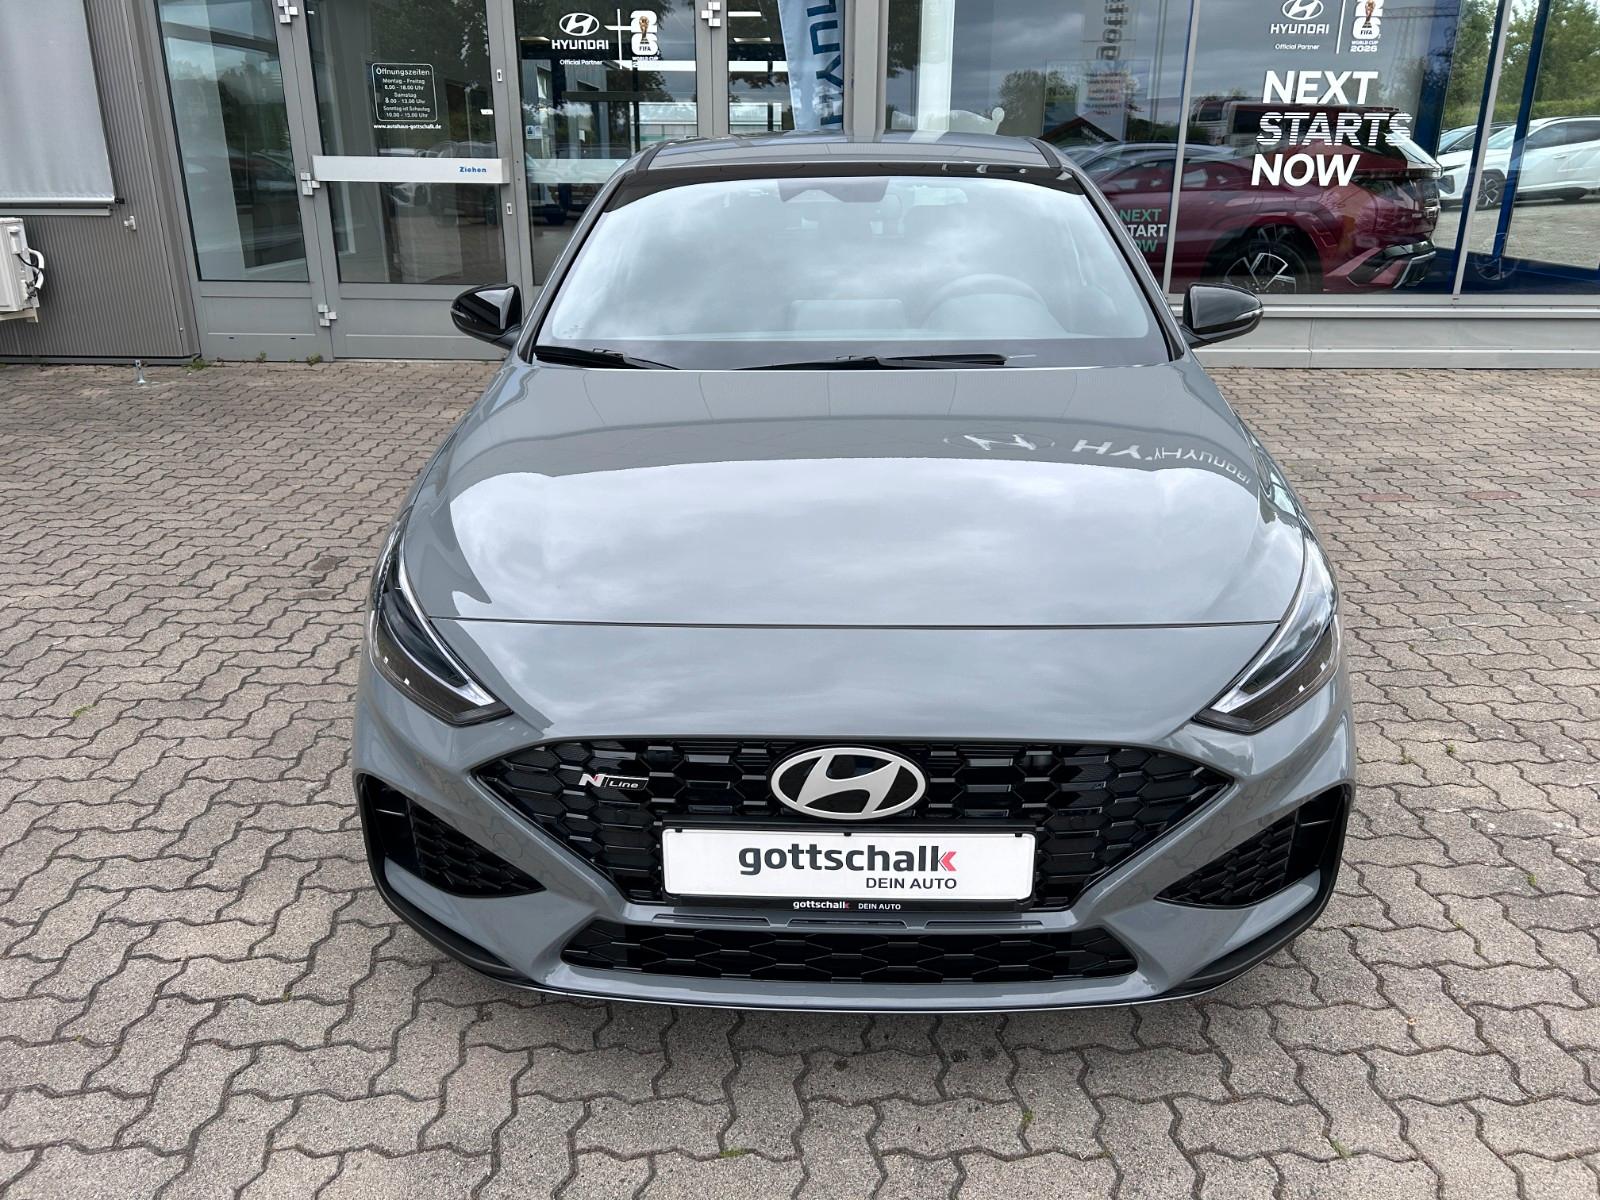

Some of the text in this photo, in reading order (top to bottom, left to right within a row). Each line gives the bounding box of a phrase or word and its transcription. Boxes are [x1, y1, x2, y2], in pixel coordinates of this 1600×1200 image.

[1270, 24, 1330, 34] HYUNDAI
[551, 40, 609, 50] HYUNDAI
[1262, 70, 1379, 105] NEXT
[1256, 111, 1413, 146] STARTS
[1251, 153, 1361, 187] NOW
[1120, 208, 1162, 222] NEXT
[1126, 224, 1167, 237] TART
[578, 773, 639, 789] N Line
[738, 843, 957, 876] gottschalk
[865, 877, 957, 890] DEIN AUTO
[793, 900, 849, 910] gottschalk
[858, 902, 877, 910] DEIN
